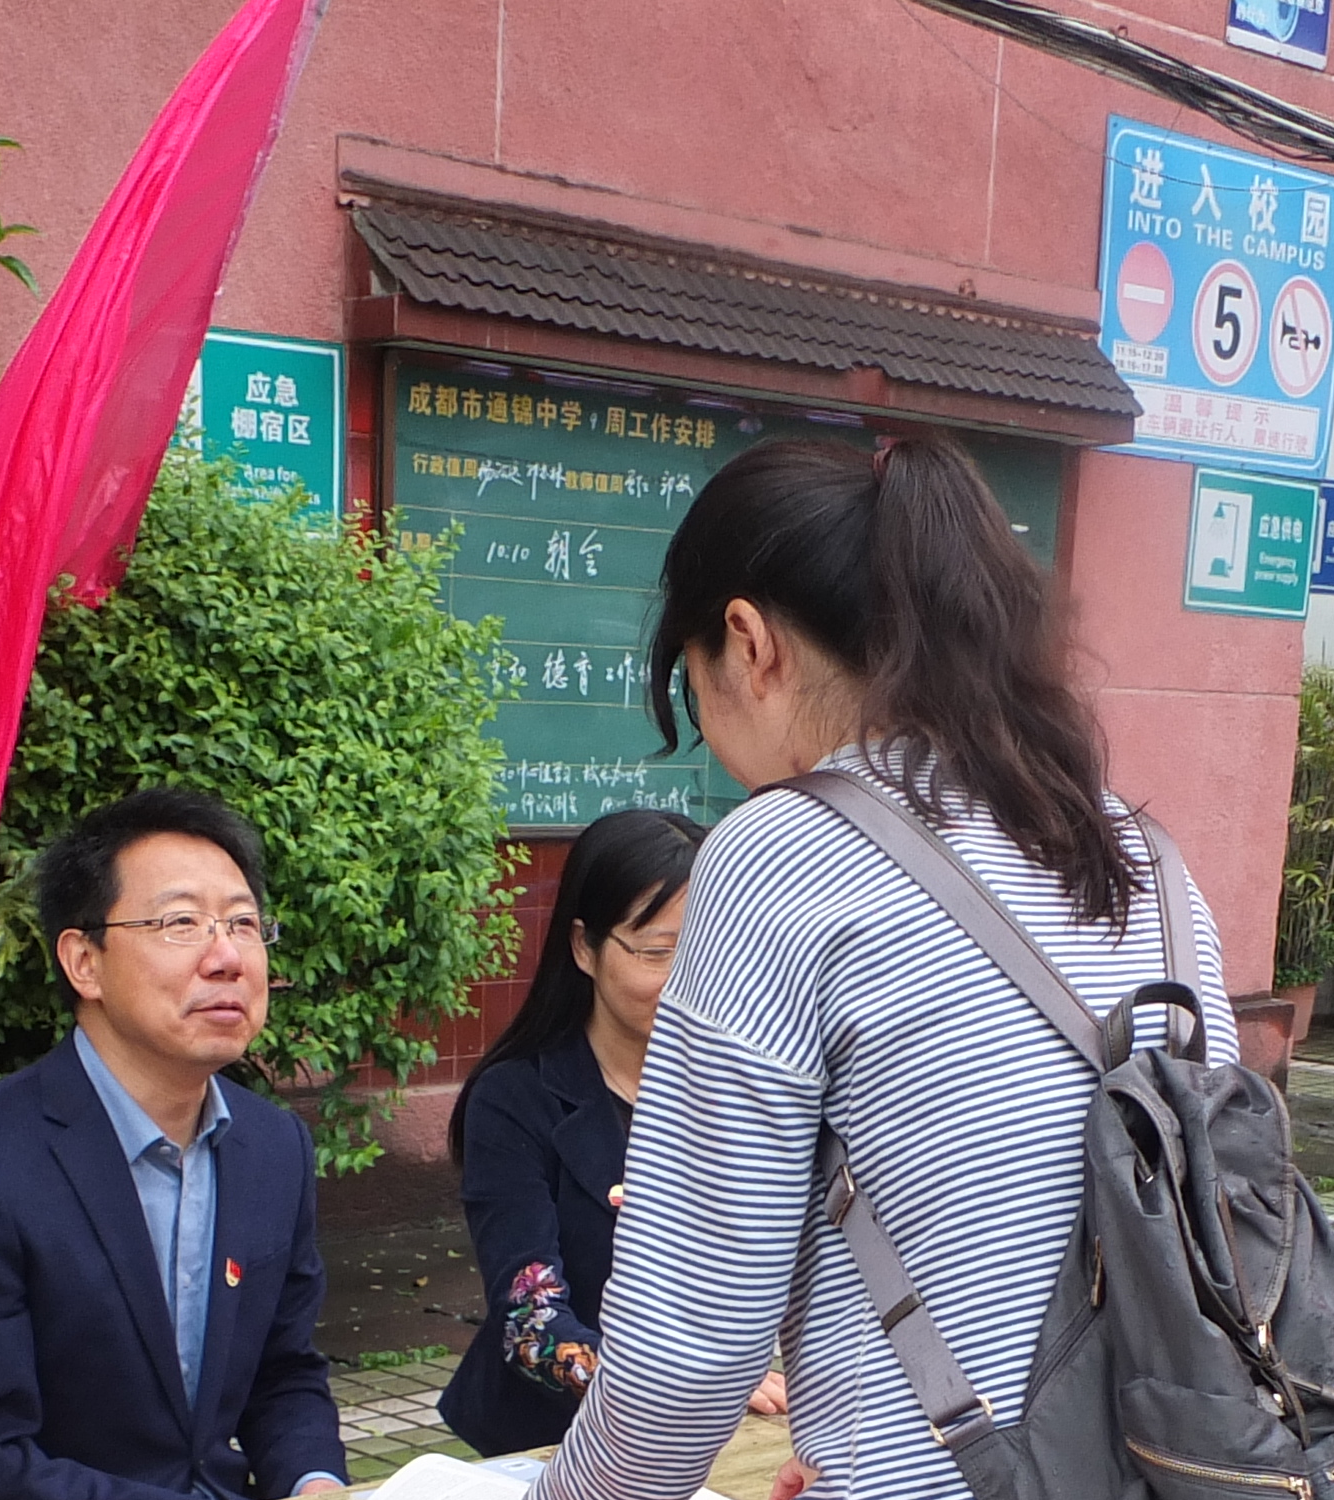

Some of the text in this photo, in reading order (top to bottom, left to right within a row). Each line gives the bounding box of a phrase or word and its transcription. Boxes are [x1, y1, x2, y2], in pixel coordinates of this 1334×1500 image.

[1129, 147, 1331, 248] 进入校园
[1127, 209, 1326, 272] INTO THE CAMPUS
[1213, 284, 1243, 361] 5
[245, 371, 299, 407] 应急
[1164, 393, 1271, 424] 温馨提示
[231, 405, 311, 446] 棚宿区
